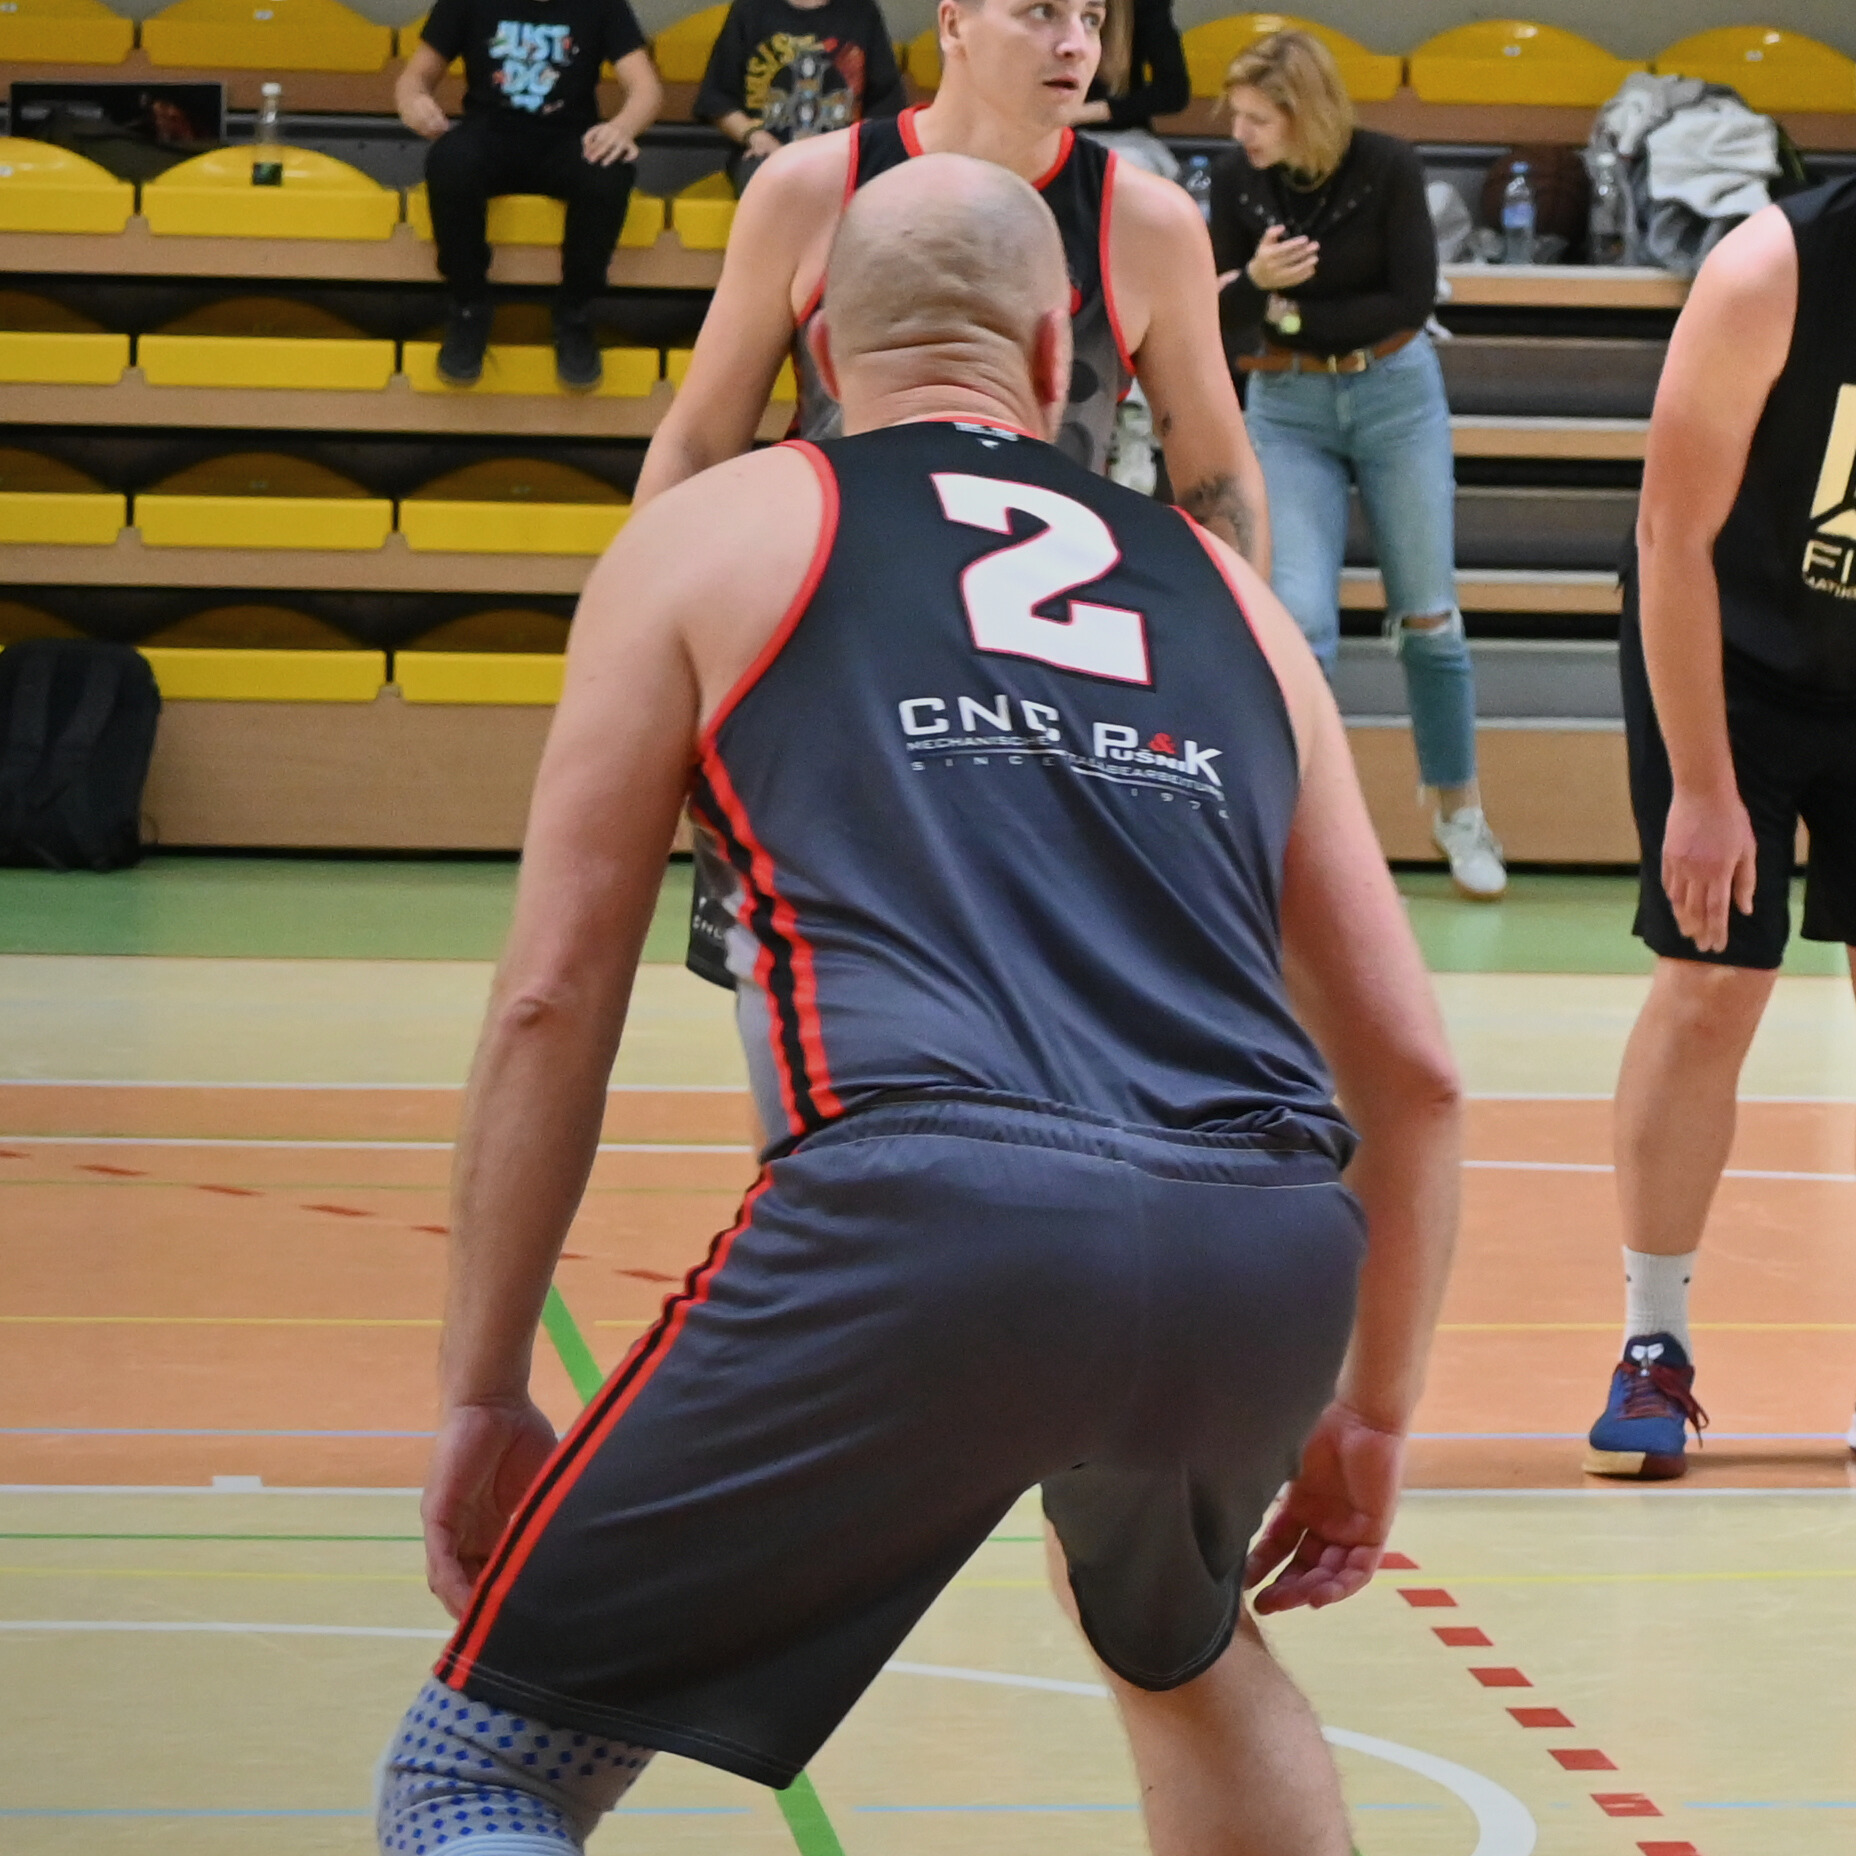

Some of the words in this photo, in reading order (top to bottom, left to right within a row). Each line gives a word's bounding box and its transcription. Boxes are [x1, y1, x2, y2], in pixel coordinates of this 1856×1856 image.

[488, 20, 571, 62] JUST
[929, 472, 1152, 686] 2
[899, 694, 1060, 742] CNC
